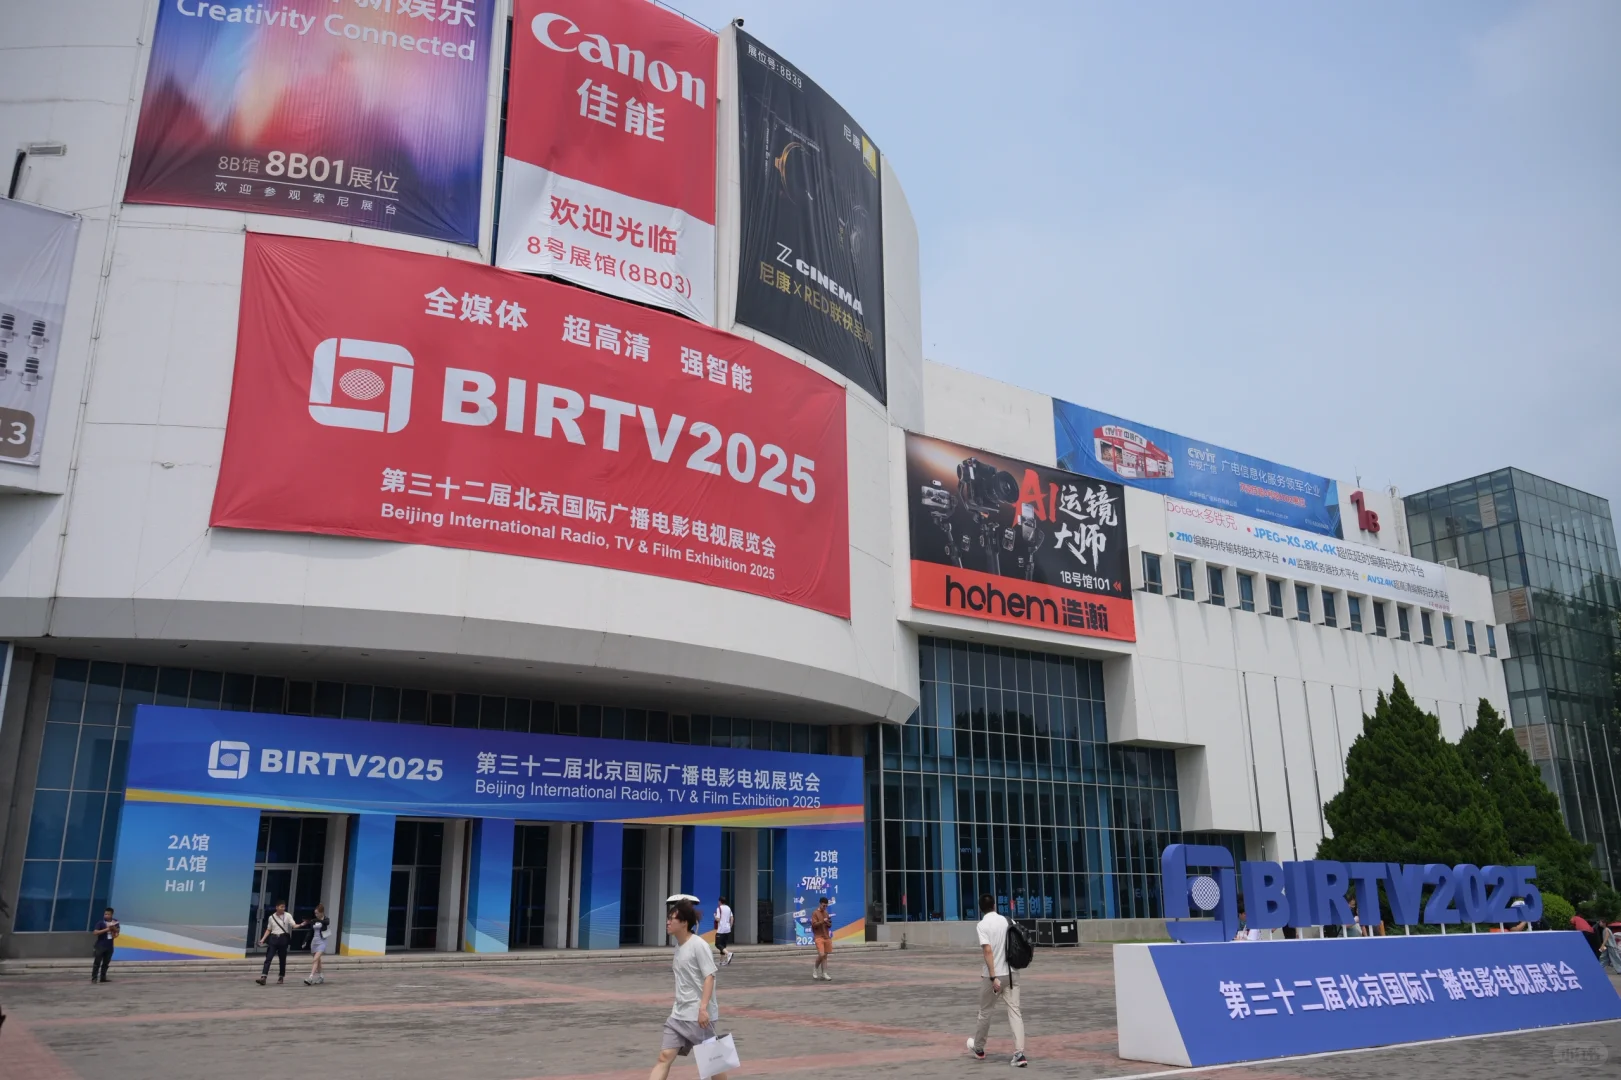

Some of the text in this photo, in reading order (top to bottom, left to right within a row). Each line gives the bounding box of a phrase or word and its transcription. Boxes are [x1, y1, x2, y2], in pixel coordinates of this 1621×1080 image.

[176, 0, 476, 61] Creativity Connected
[531, 12, 706, 109] Canon
[576, 78, 665, 142] 佳能
[843, 124, 860, 152] 尼康
[218, 156, 260, 174] 8B馆
[214, 181, 397, 215] 欢迎参观索尼展台
[549, 194, 678, 255] 欢迎光临
[527, 236, 692, 299] 8号展馆(8B03)
[795, 258, 863, 316] CINEMA
[424, 286, 753, 394] 全媒体 超高清 强智能
[441, 367, 816, 504] BIRTV2025
[380, 467, 776, 559] 第三十二届北京国际广播电影电视展览会
[381, 502, 775, 580] Beijing International Radio, TV & Film Exhibition 2025
[1053, 522, 1107, 573] 大师
[945, 574, 1109, 632] hohem 浩瀚
[1060, 570, 1111, 591] 1B号馆101
[260, 748, 443, 781] BIRTV2025
[476, 751, 820, 793] 第三十二届北京国际广播电影电视展览会
[475, 779, 821, 809] Beijing International Radio, TV & Film Exhibition 2025
[165, 855, 208, 873] 1A馆
[167, 833, 210, 851] 2A馆
[814, 849, 838, 863] 2B馆
[164, 879, 206, 892] Hall 1
[814, 866, 838, 880] 1B馆
[834, 884, 838, 894] 1
[1239, 860, 1543, 930] BIRTV2025
[796, 936, 816, 945] 202
[1218, 960, 1583, 1020] 第三十二届北京国际广播电影电视展览会
